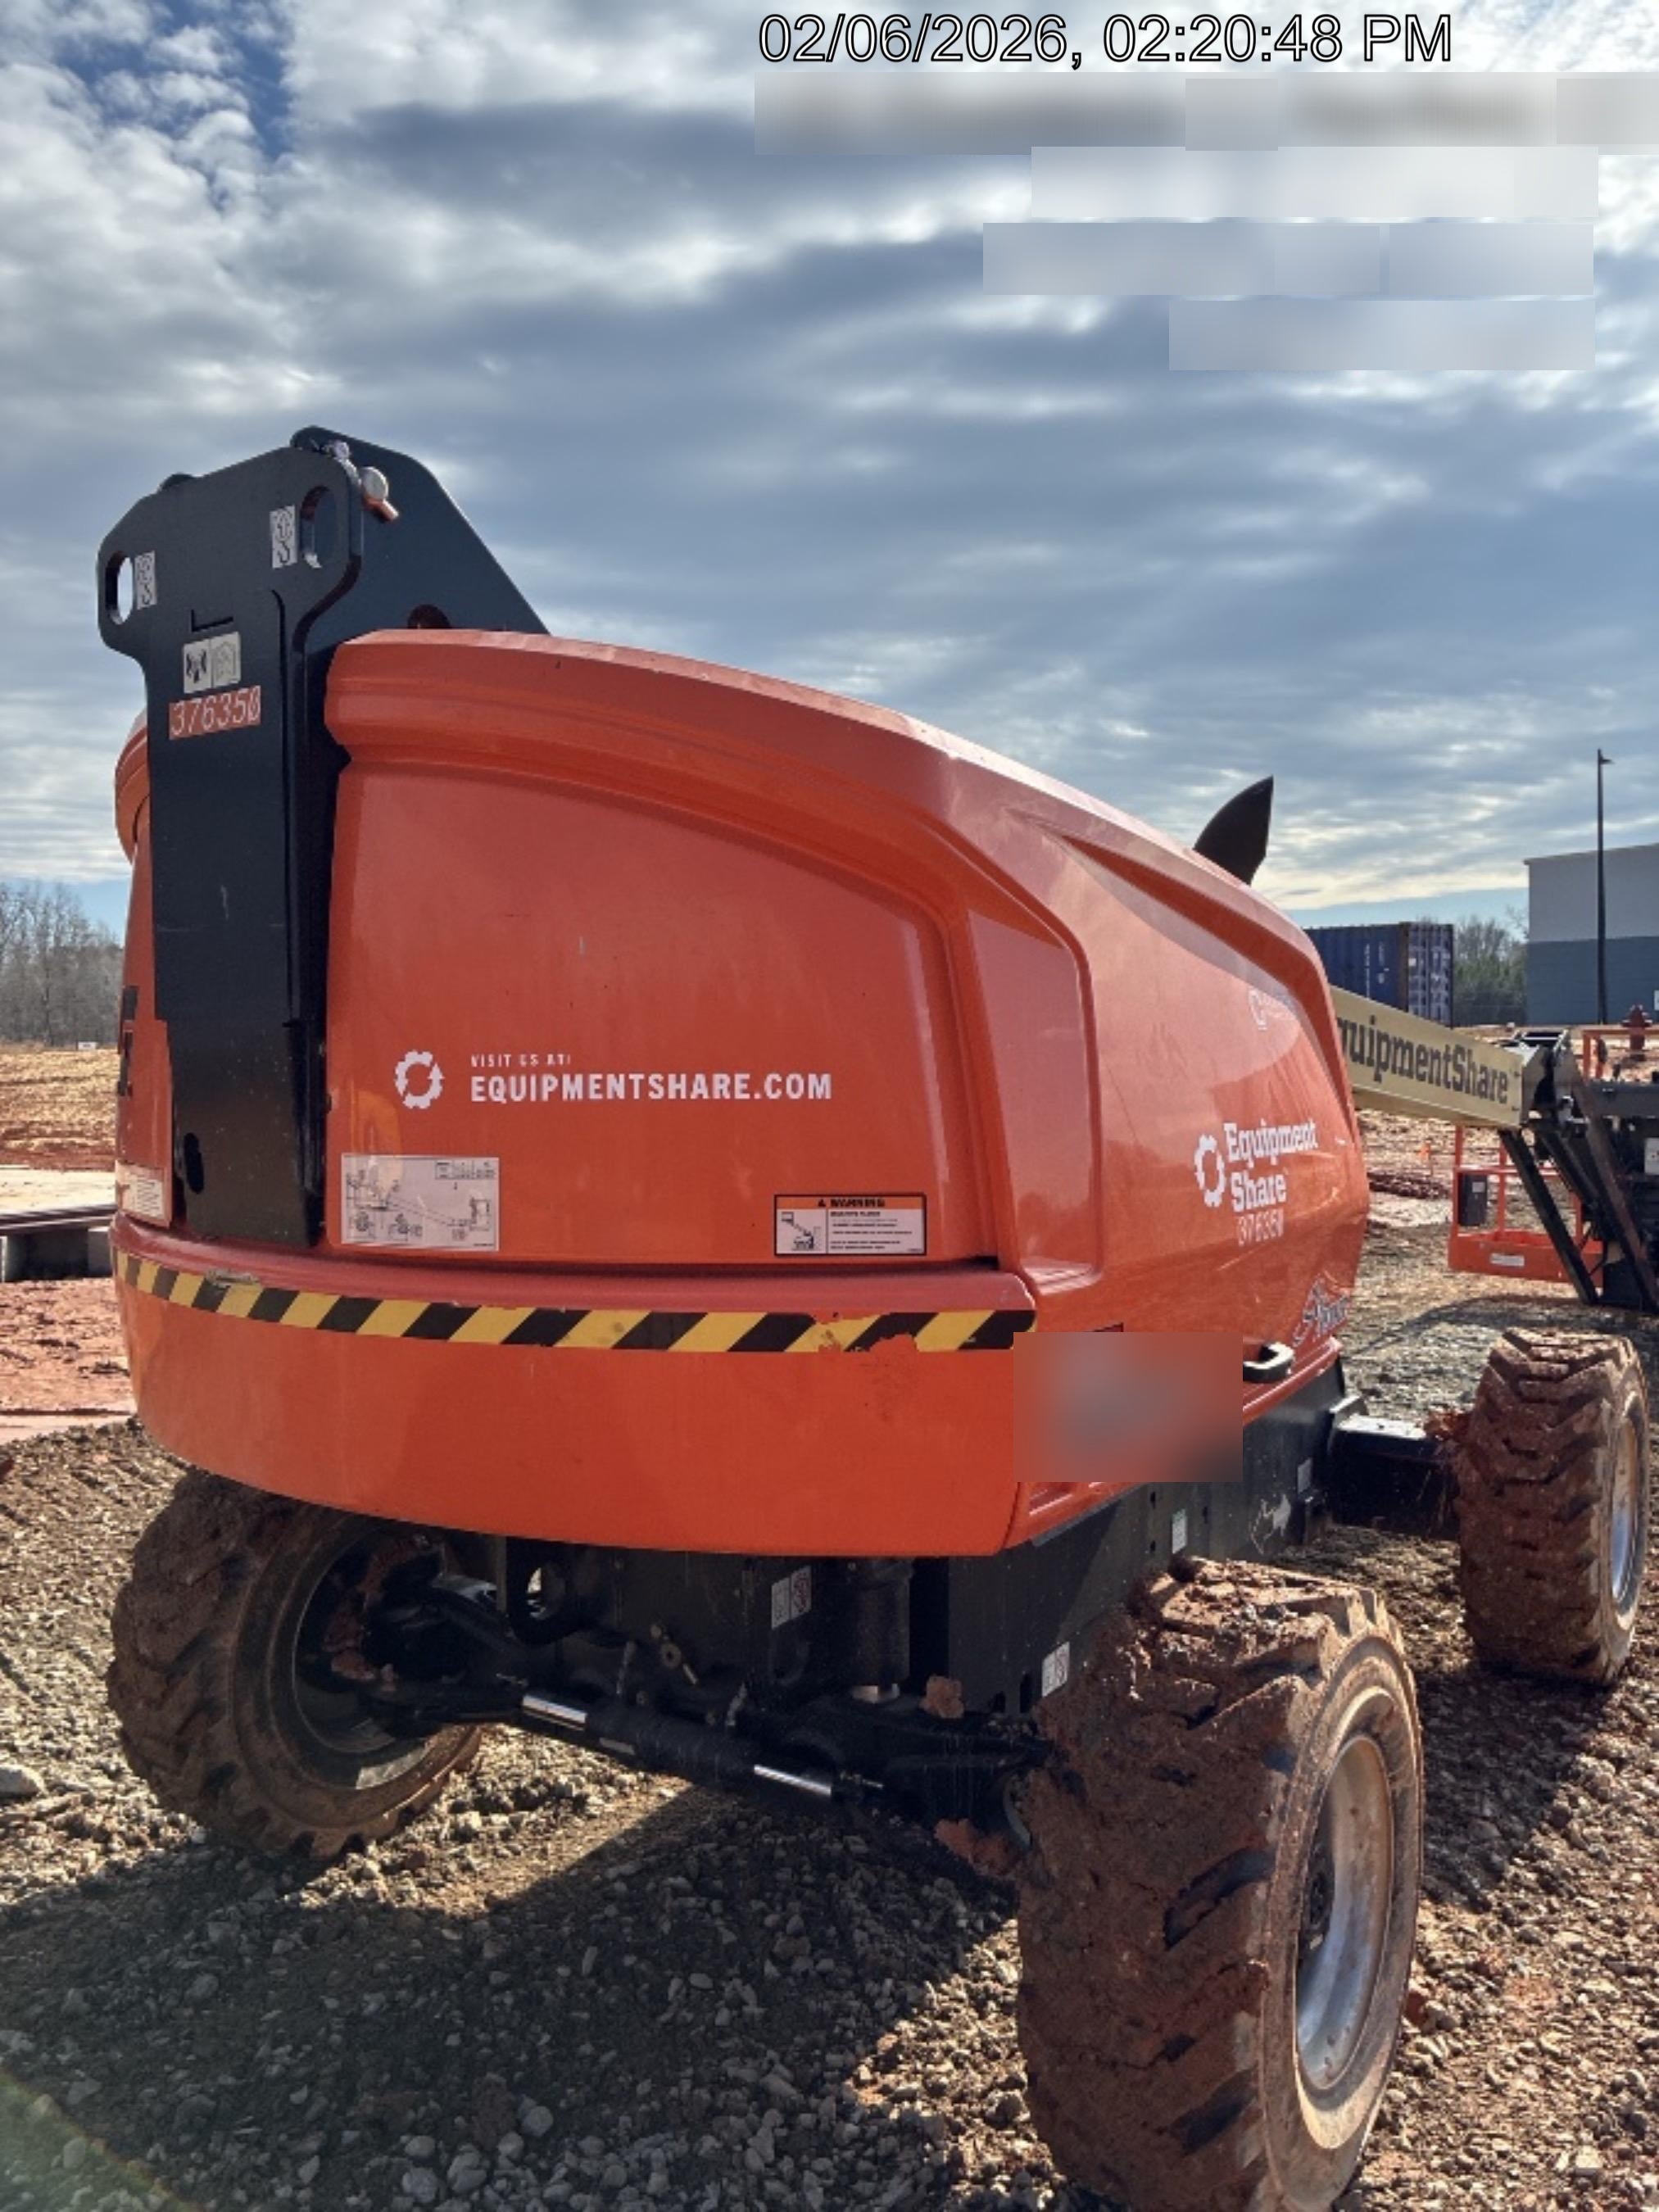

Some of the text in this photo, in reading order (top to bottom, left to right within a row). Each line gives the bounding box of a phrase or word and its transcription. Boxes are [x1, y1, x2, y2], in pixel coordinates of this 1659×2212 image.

[170, 685, 261, 736] 376350
[471, 1054, 511, 1067] VISIT
[471, 1073, 832, 1104] EQUIPMENTSHARE.COM
[1223, 1117, 1319, 1169] Equipment
[1231, 1170, 1287, 1213] Share
